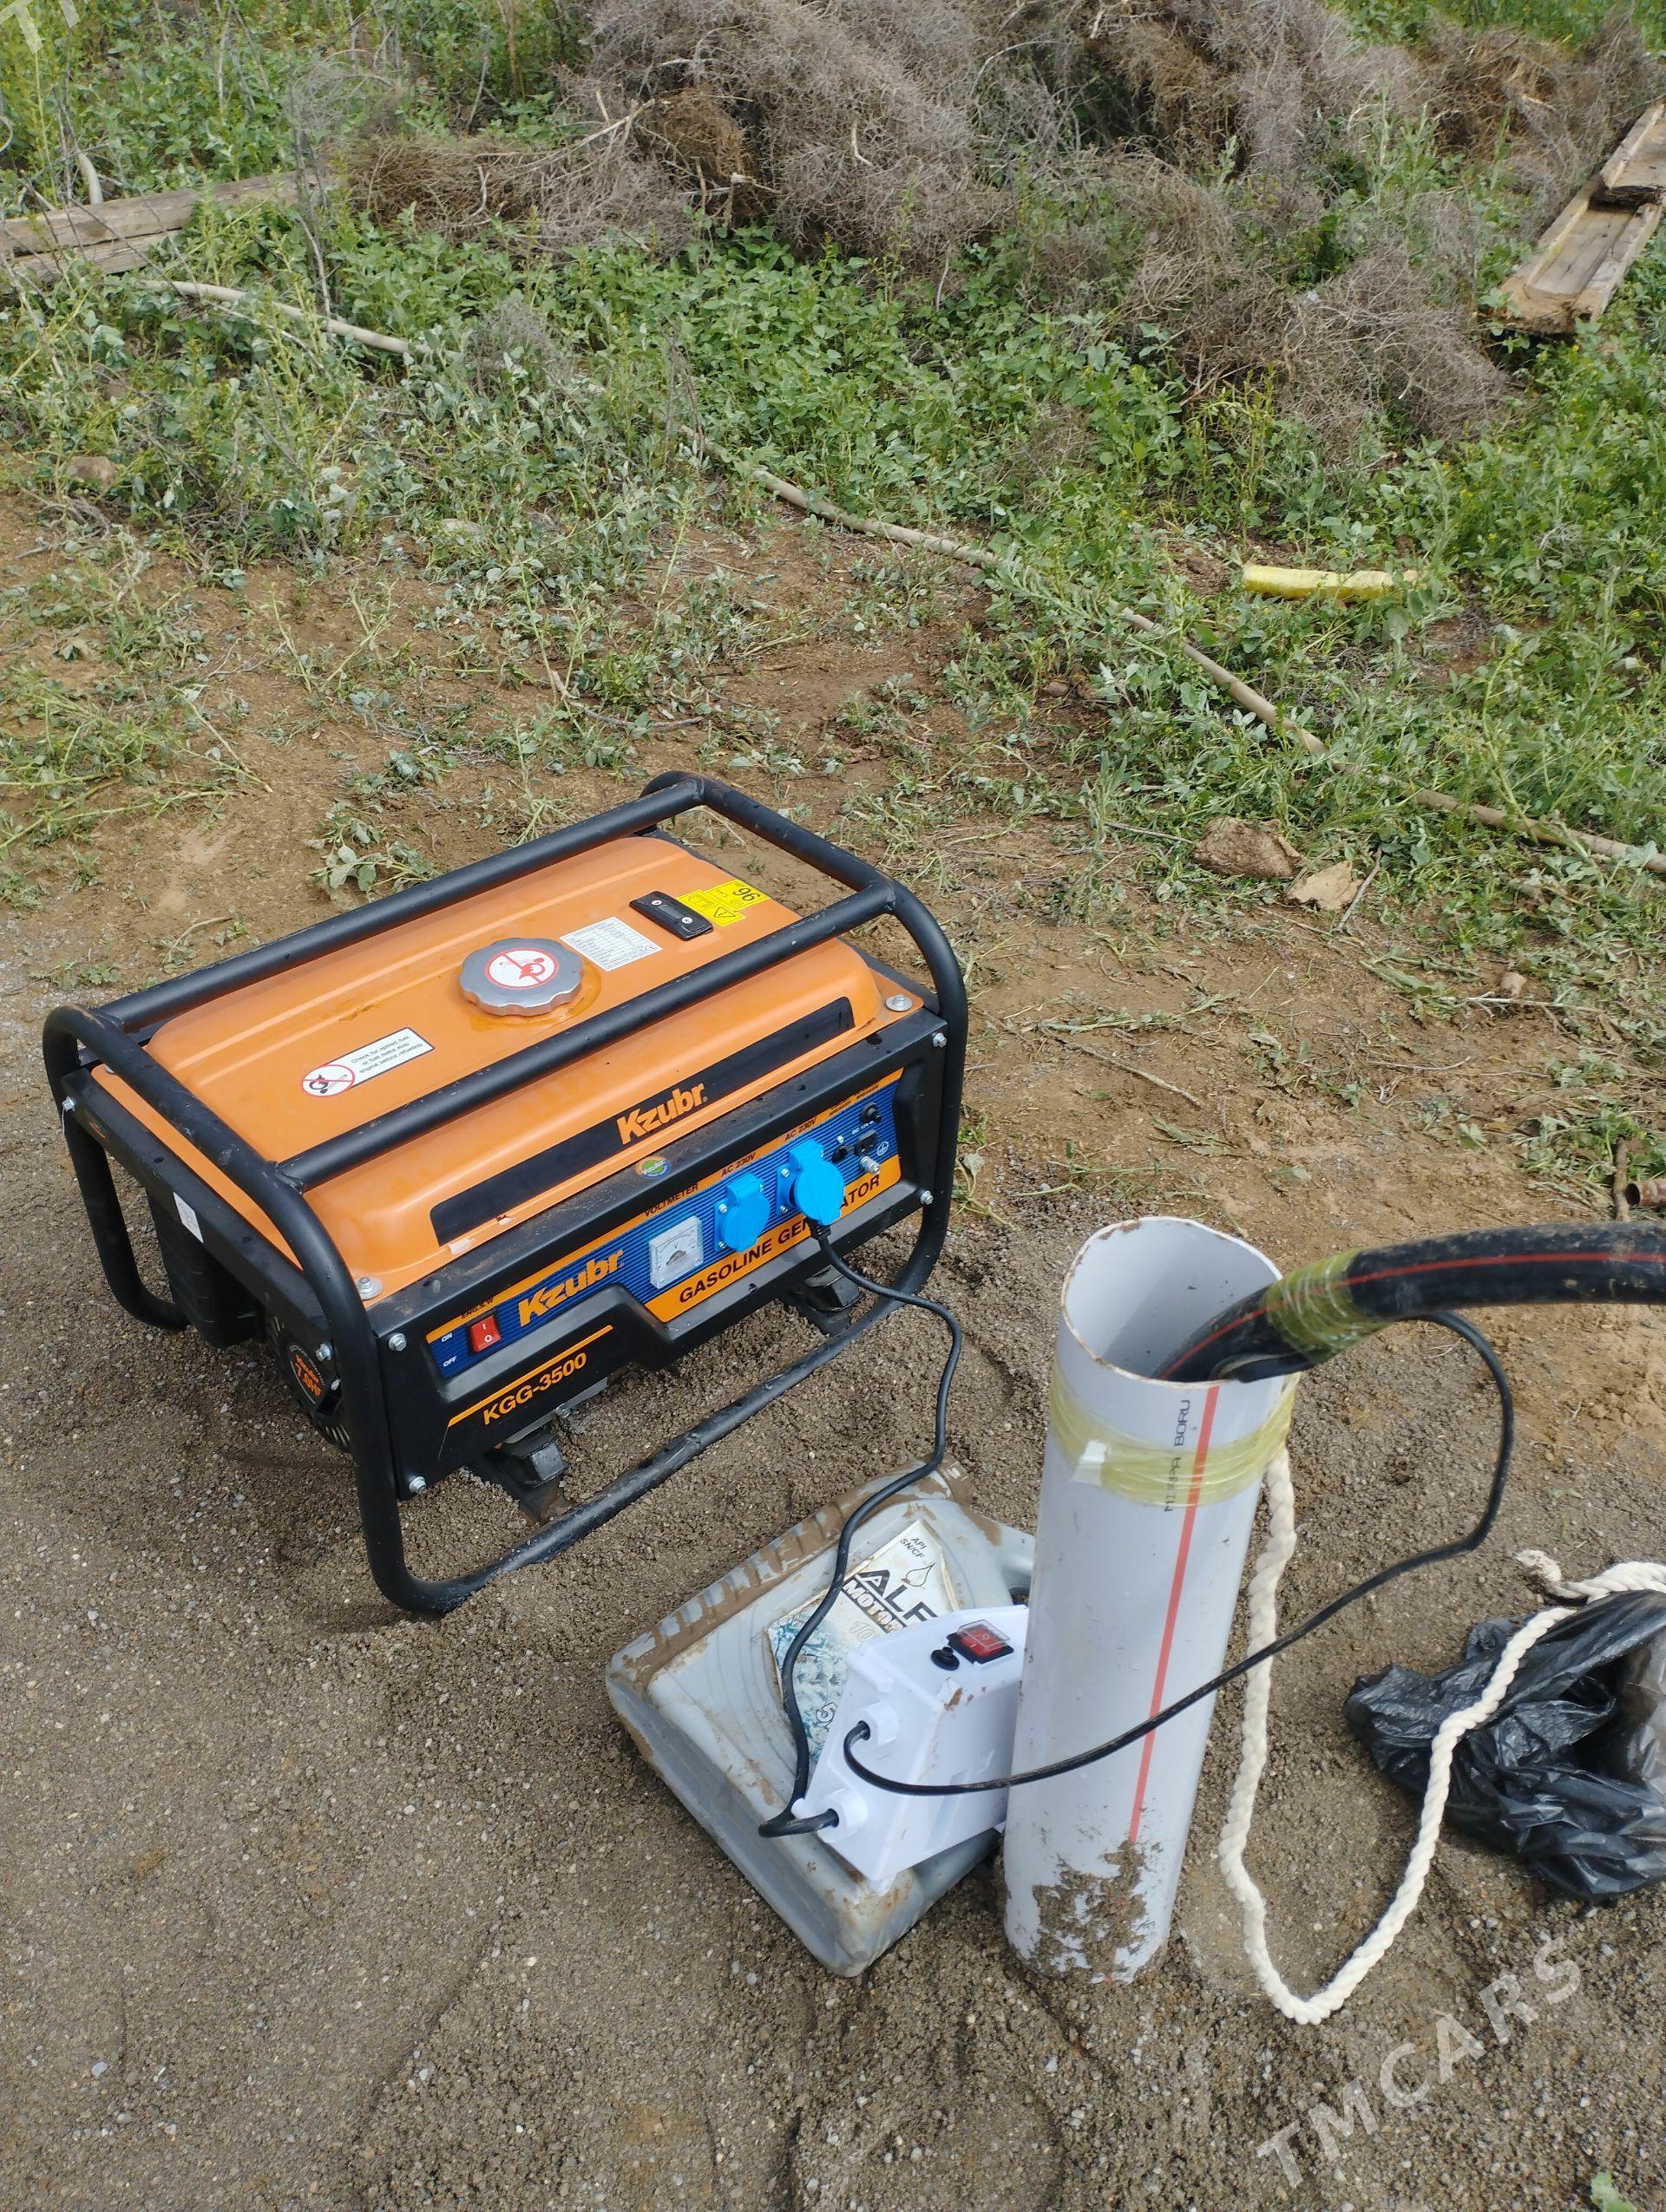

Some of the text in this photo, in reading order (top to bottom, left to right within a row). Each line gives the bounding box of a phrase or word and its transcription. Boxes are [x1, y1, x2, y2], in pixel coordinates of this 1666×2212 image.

[731, 887, 761, 902] 96
[616, 1083, 705, 1145] Kzubr
[784, 1117, 817, 1142] AC 230V
[721, 1152, 756, 1178] AC 230V
[644, 1183, 699, 1217] VOLTMETER
[679, 1238, 773, 1303] GASOLINE
[518, 1249, 623, 1327] Kzubr
[483, 1352, 587, 1426] KGG-3500
[1174, 1399, 1191, 1447] BORU
[899, 1538, 926, 1560] SN/CF
[911, 1536, 928, 1550] API
